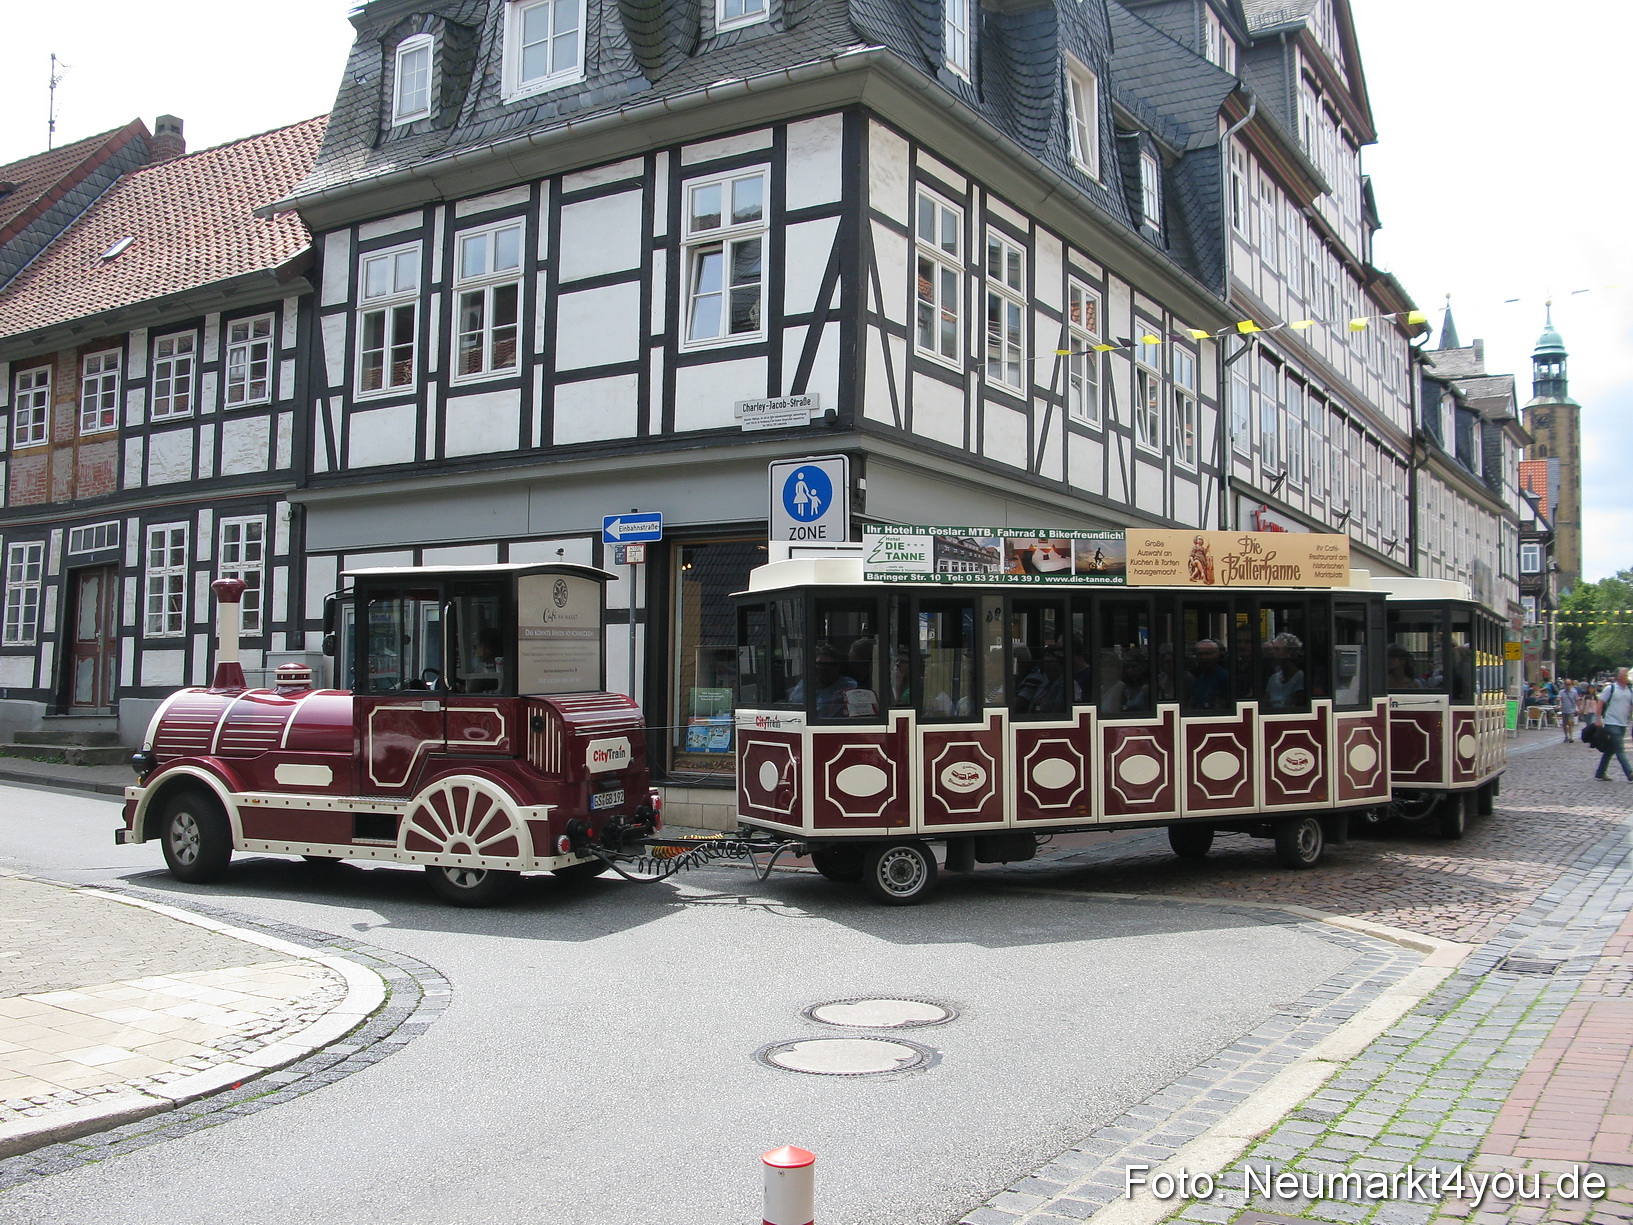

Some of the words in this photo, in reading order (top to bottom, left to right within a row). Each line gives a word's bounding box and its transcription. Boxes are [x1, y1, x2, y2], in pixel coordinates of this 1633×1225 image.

[742, 396, 811, 412] Charley-Jacob-Straße
[618, 523, 658, 532] Einbahnstraße
[788, 525, 827, 540] ZONE
[866, 525, 881, 534] Ihr
[884, 526, 913, 535] Hotel
[916, 526, 926, 535] in
[928, 526, 966, 536] Goslar:
[968, 528, 995, 538] MTB,
[997, 528, 1036, 538] Fahrrad
[1038, 529, 1047, 538] &
[1049, 530, 1124, 540] Bikerfreundlich!
[885, 542, 905, 550] DIE
[1238, 535, 1262, 556] Die
[885, 552, 926, 561] TANNE
[1221, 551, 1301, 586] Butterhanne
[866, 573, 908, 582] Bäringer
[755, 714, 781, 730] CityTrain
[593, 745, 626, 763] CityTrain
